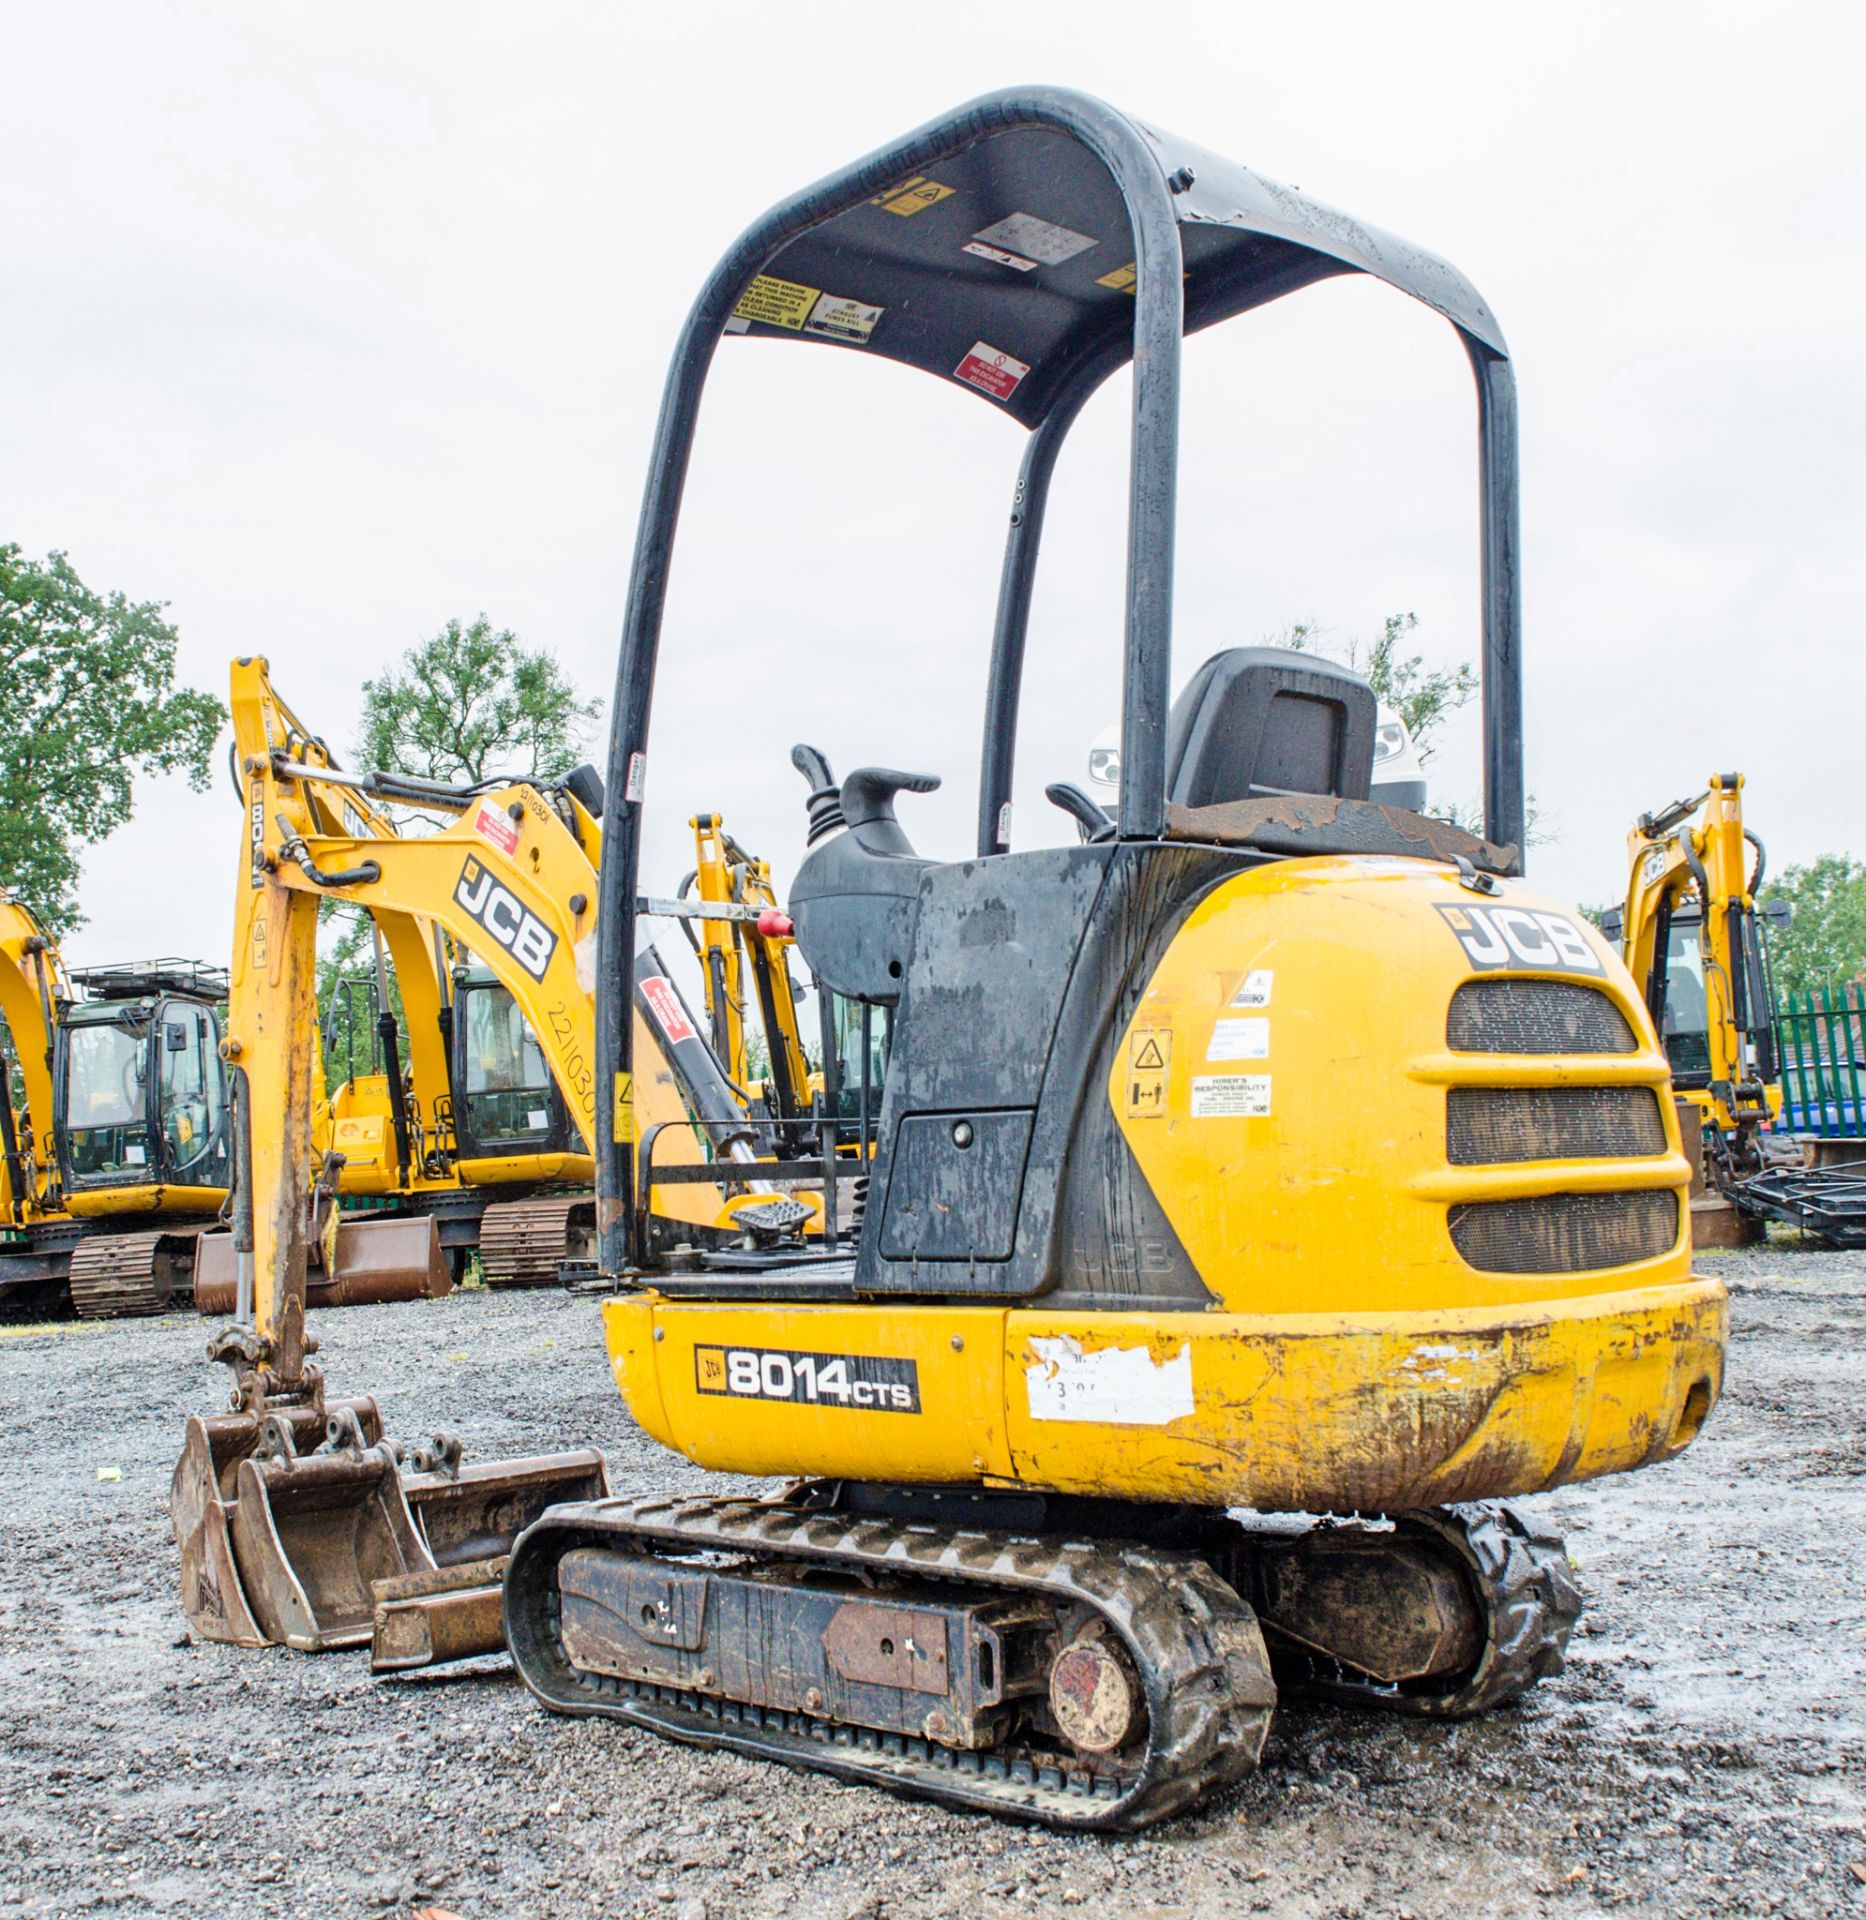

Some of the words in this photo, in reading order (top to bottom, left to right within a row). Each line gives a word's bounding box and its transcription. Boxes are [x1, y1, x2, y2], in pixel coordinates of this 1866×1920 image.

[457, 873, 553, 977] JCB
[1460, 906, 1601, 970] JCB
[1194, 1084, 1266, 1092] RESPONSIBILITY
[705, 1359, 721, 1378] JCB
